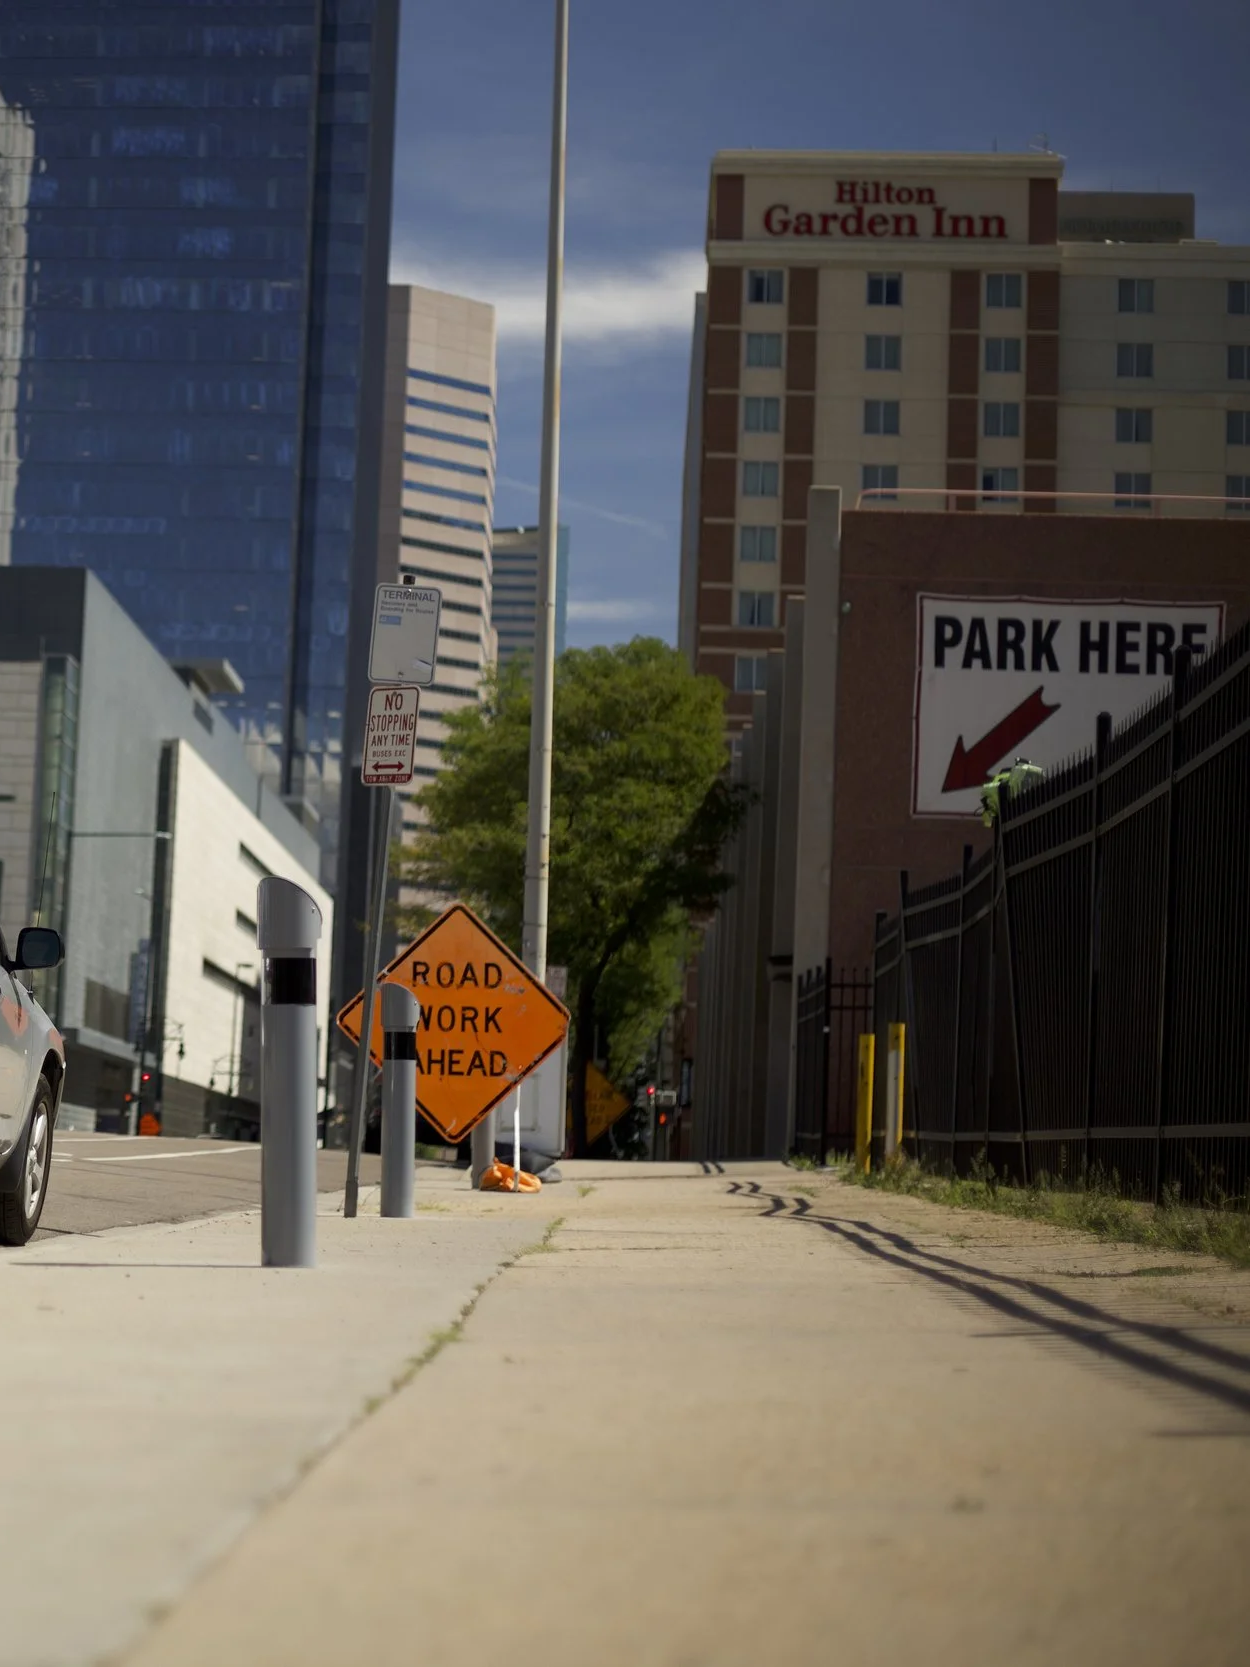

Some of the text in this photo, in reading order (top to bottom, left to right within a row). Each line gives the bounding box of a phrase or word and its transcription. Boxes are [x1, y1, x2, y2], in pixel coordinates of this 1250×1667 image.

[835, 180, 937, 206] Hilton
[764, 203, 1008, 239] Garden Inn
[383, 590, 435, 602] TERMINAL
[934, 615, 1061, 672] PARK
[384, 693, 403, 711] NO
[370, 714, 414, 732] STOPPING
[371, 734, 410, 747] ANY TIME
[372, 749, 406, 758] BUSES EXC
[366, 775, 377, 783] TOW
[395, 774, 409, 782] ZONE
[412, 961, 502, 989] ROAD
[416, 1004, 502, 1033] WORK
